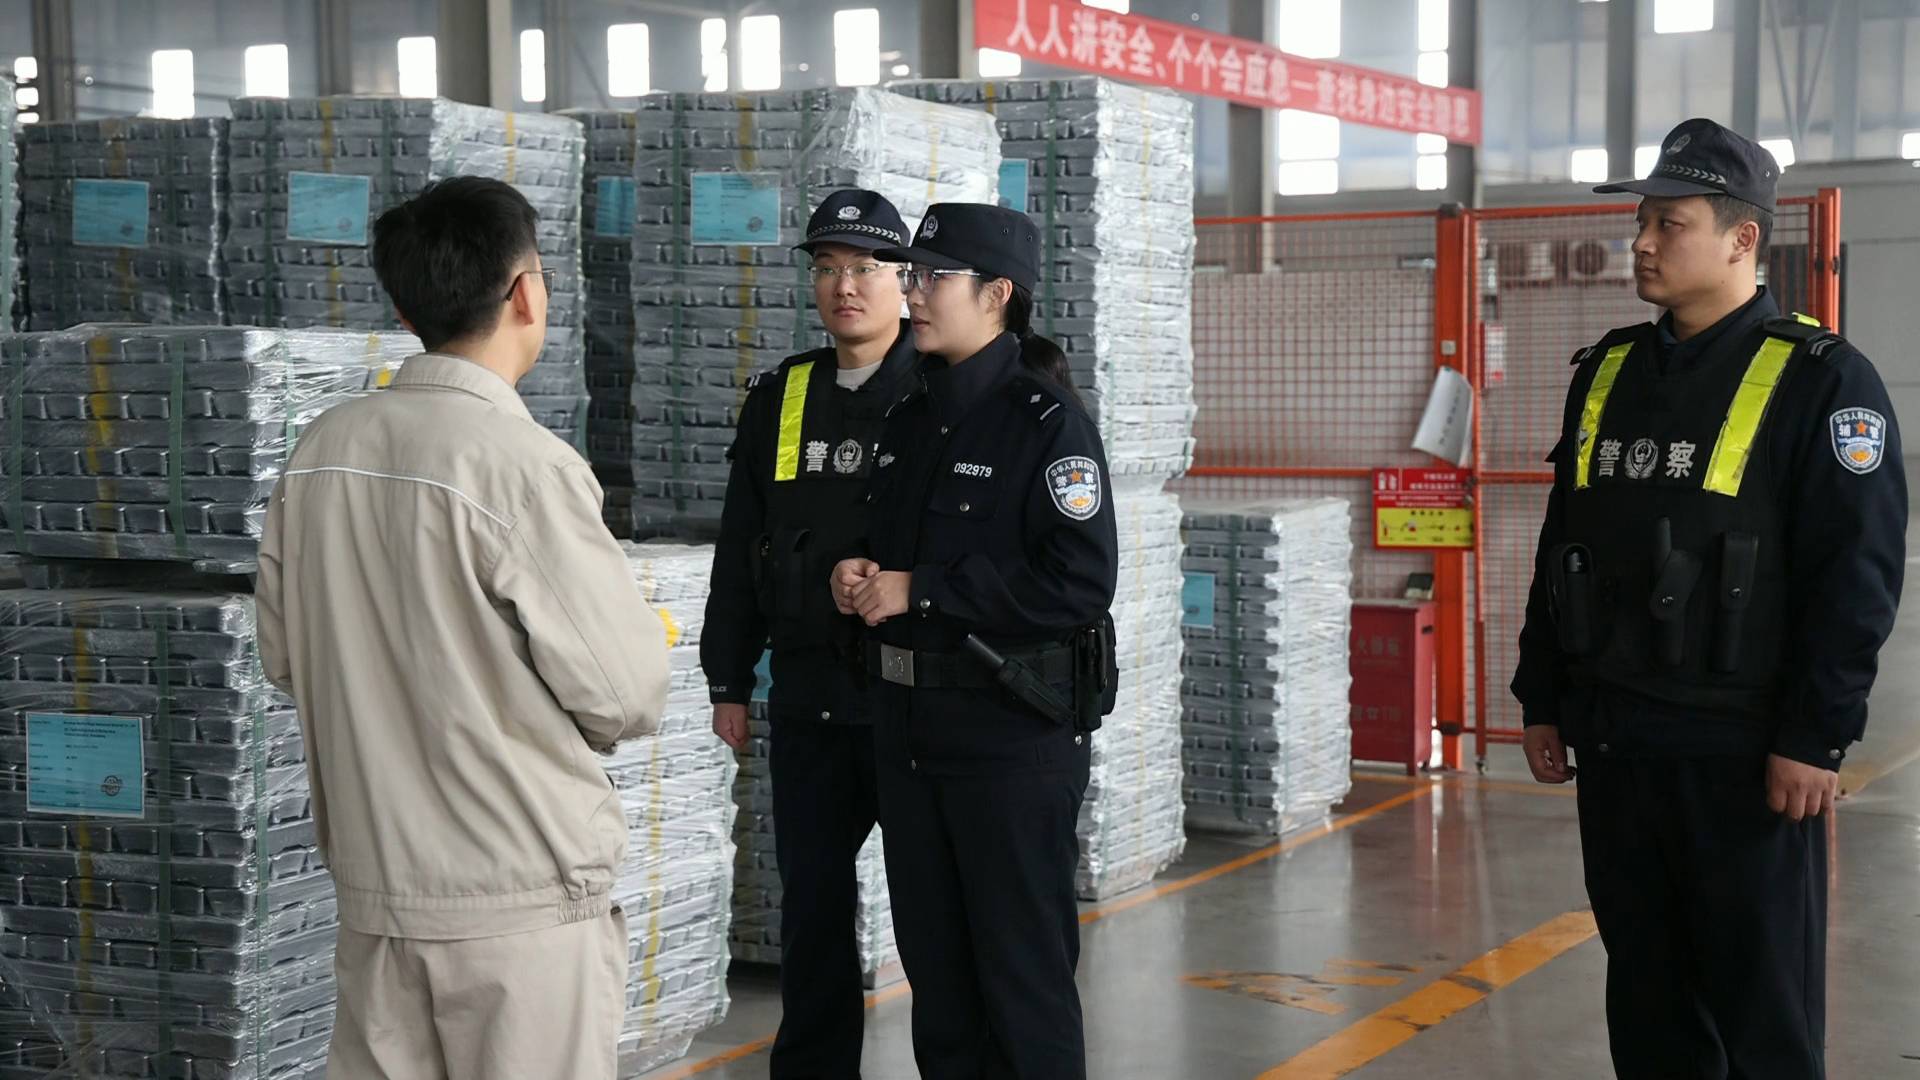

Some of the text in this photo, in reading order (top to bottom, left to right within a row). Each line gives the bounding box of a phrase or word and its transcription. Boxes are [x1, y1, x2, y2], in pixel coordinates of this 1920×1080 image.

[805, 440, 829, 473] 警
[954, 462, 993, 478] 092979
[1598, 439, 1697, 479] 警 察
